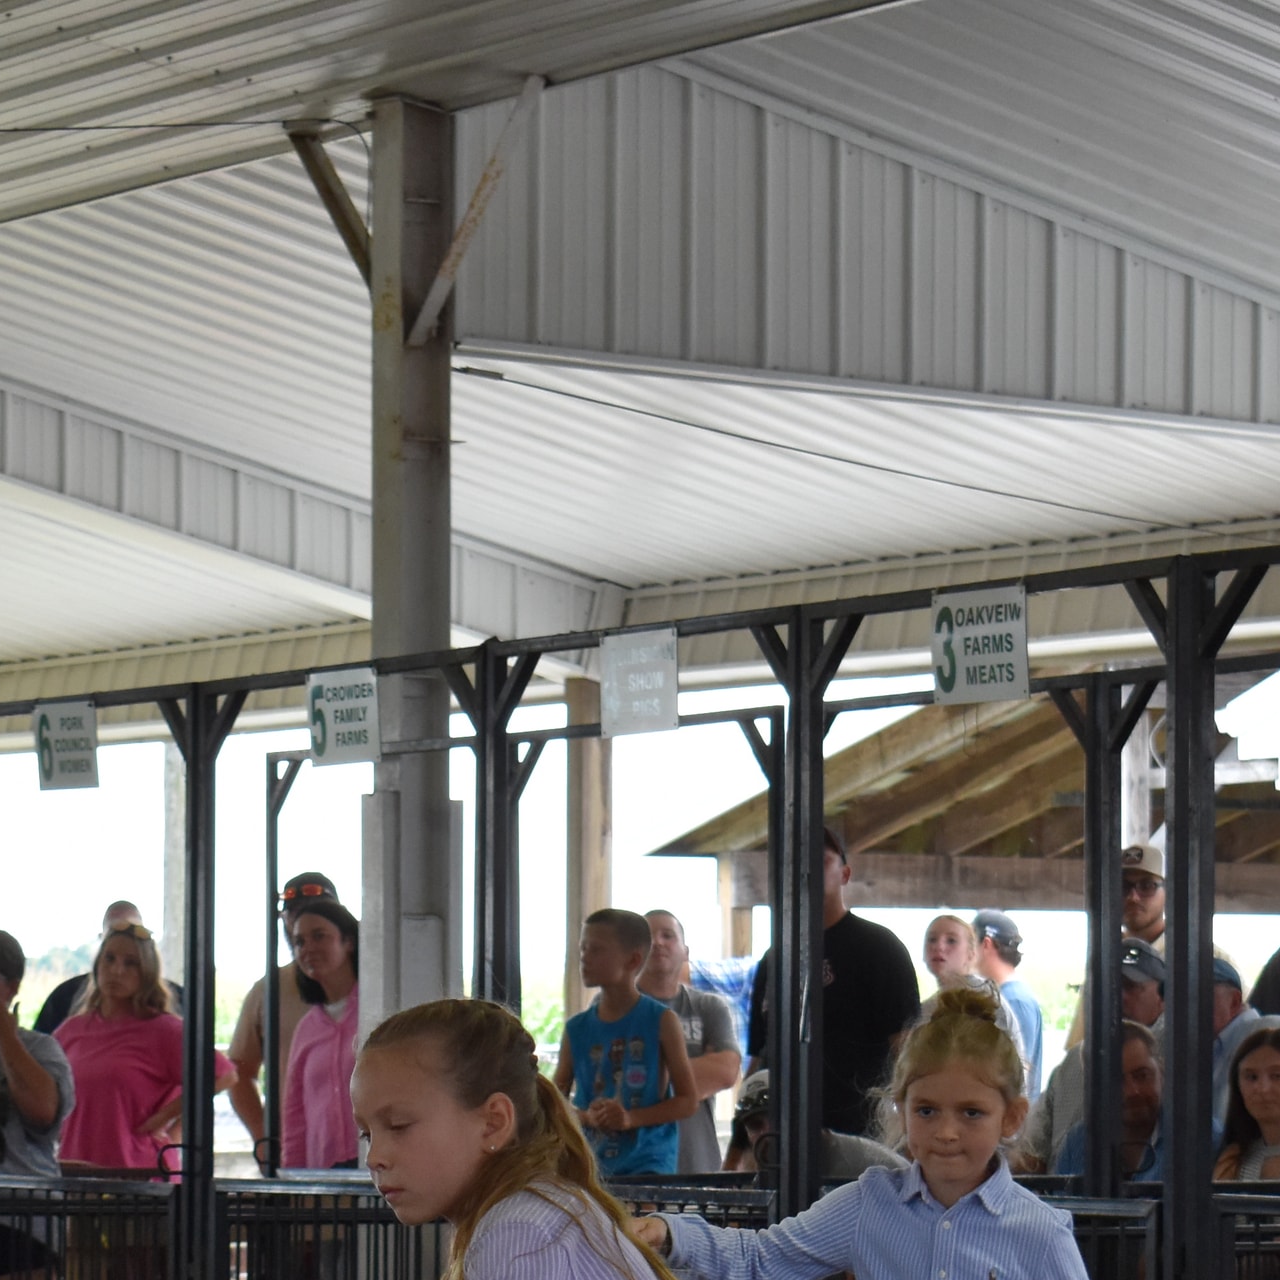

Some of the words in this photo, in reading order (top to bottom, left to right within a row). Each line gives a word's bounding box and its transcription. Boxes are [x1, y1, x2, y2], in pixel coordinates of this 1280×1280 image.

[955, 602, 1021, 627] OAKVEIW
[935, 606, 956, 693] 3
[963, 633, 1013, 656] FARMS
[966, 662, 1015, 685] MEATS
[325, 682, 373, 702] CROWDER
[311, 684, 327, 757] 5
[334, 706, 368, 724] FAMILY
[38, 713, 53, 782] 6
[336, 729, 368, 747] FARMS
